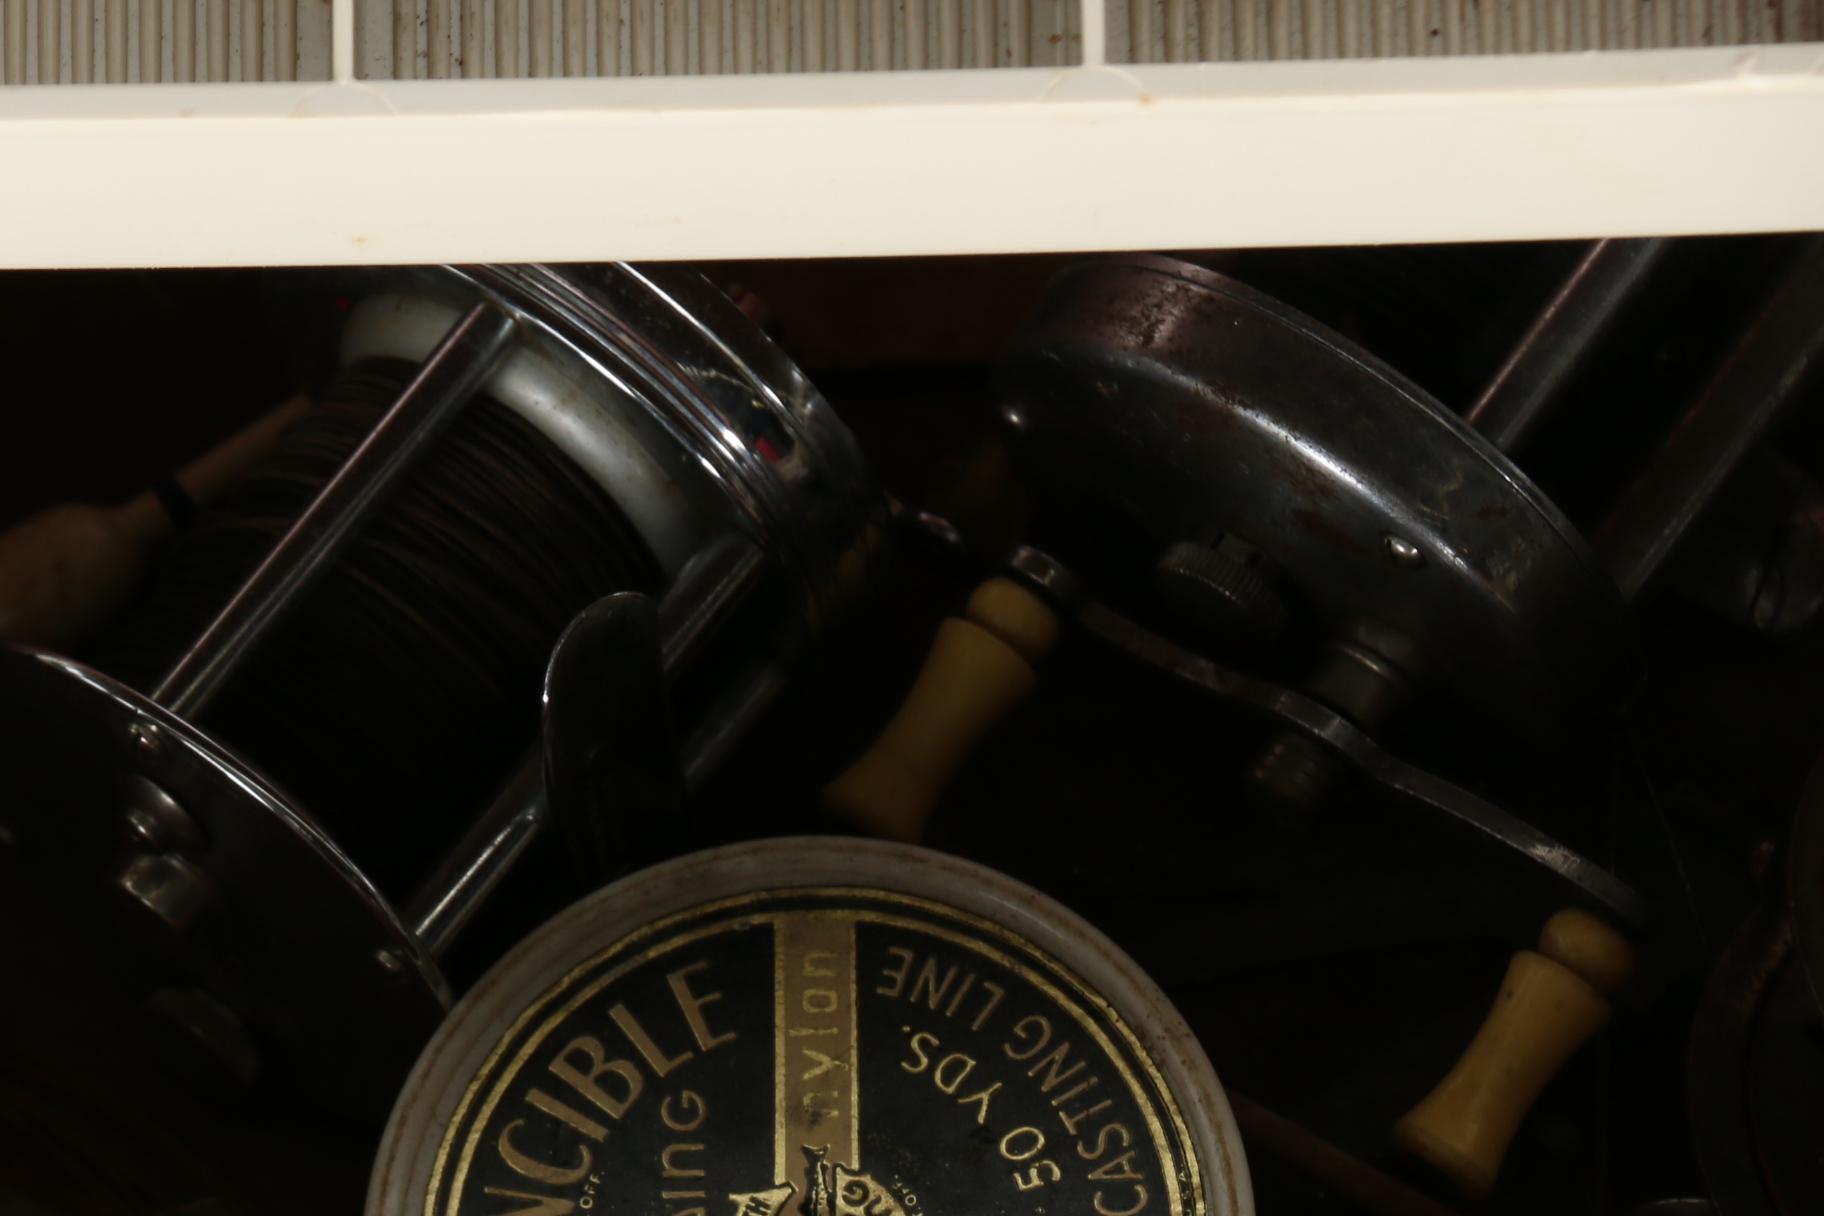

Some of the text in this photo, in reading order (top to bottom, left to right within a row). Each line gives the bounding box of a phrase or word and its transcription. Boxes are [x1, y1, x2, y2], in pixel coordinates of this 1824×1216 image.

[875, 945, 1007, 1032] LINE
[900, 1024, 1003, 1126] YDS.
[999, 1126, 1062, 1192] 50
